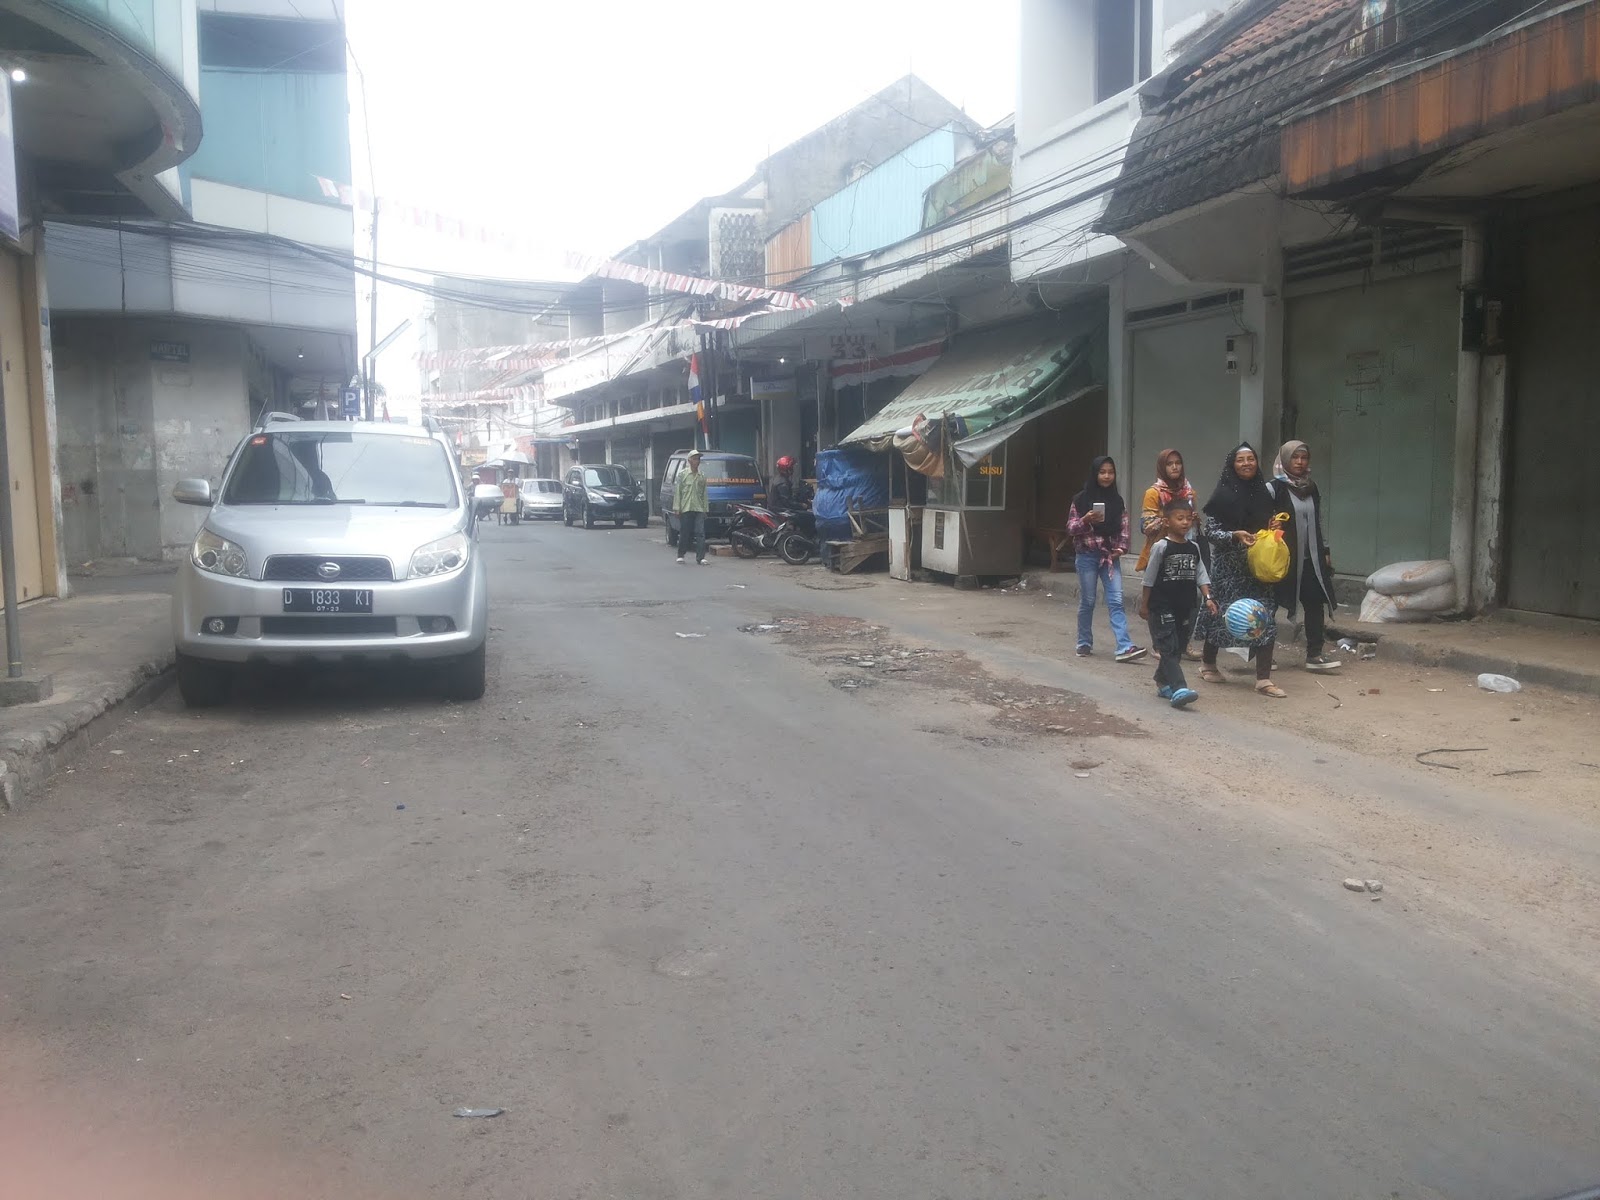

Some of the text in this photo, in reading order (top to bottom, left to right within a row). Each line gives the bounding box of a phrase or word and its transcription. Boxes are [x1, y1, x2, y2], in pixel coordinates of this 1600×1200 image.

[345, 391, 357, 406] P
[979, 466, 1003, 476] SUSU
[284, 590, 370, 606] D 1833 KI
